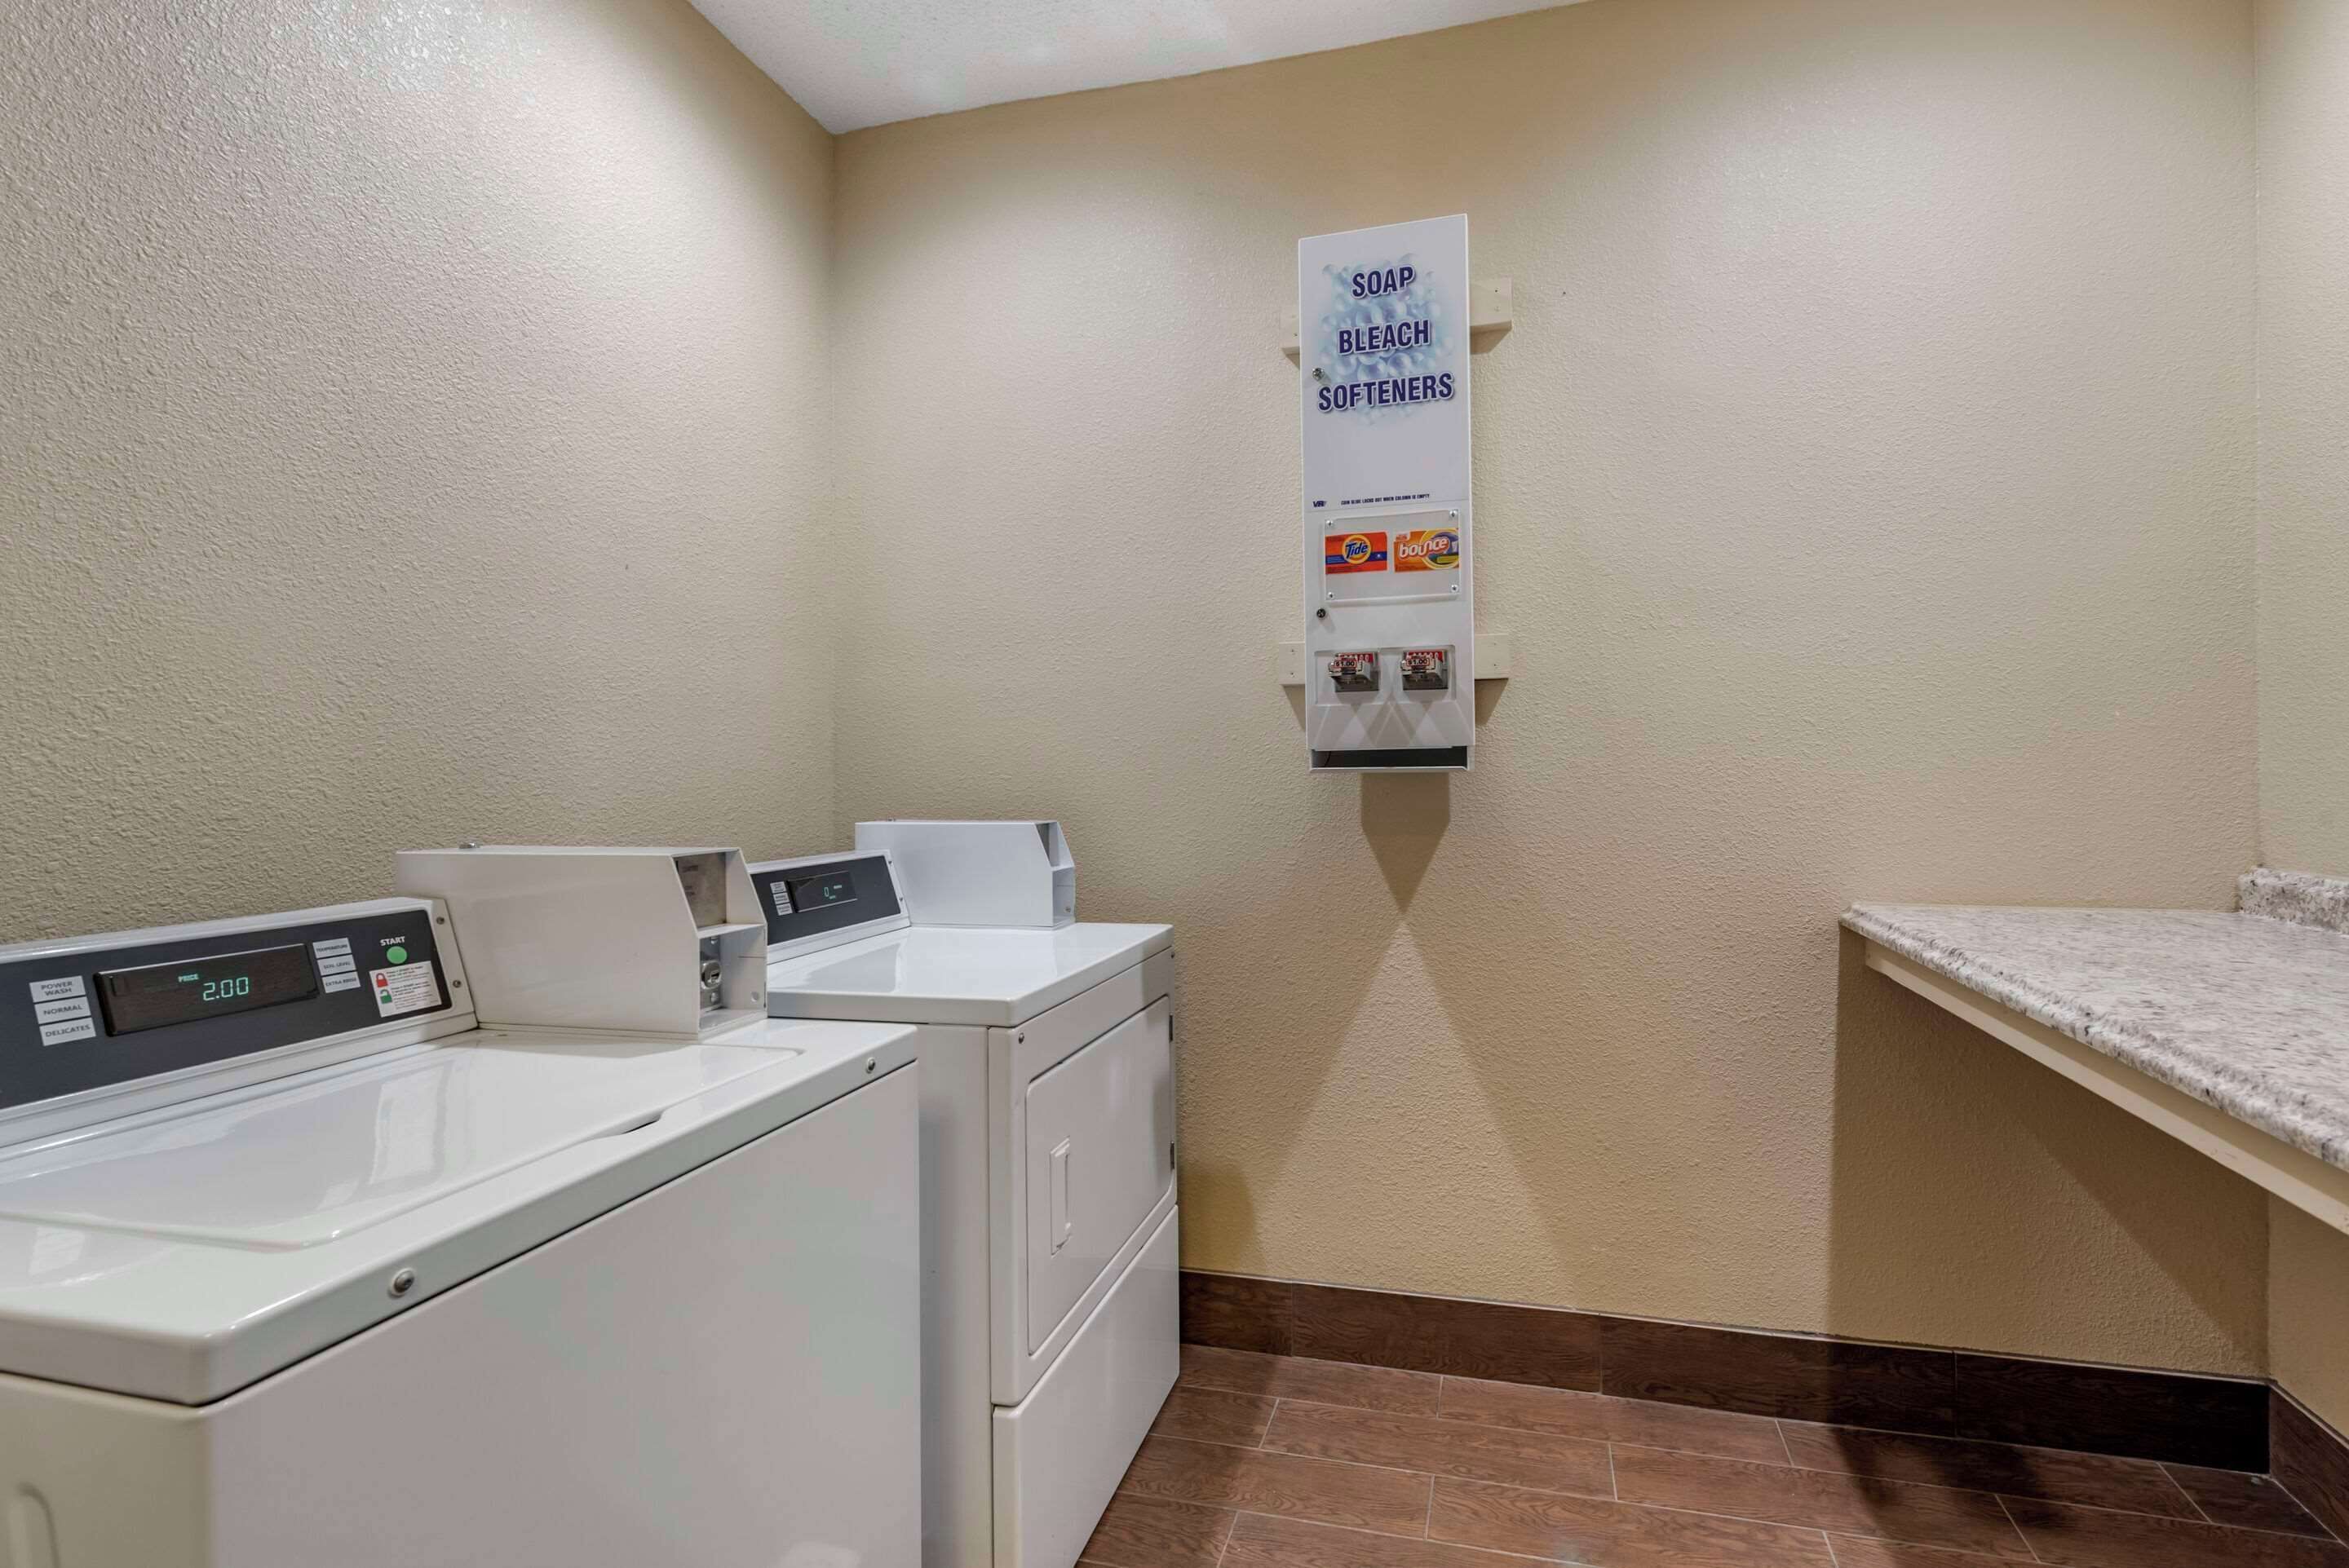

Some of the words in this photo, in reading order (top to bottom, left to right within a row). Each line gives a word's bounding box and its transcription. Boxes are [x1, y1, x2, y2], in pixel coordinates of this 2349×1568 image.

[1351, 266, 1414, 298] SOAP
[1338, 319, 1429, 354] BLEACH
[1318, 373, 1453, 411] SOFTENERS
[1345, 541, 1369, 559] Tide
[1398, 537, 1449, 559] bounce
[379, 936, 405, 947] START
[41, 981, 73, 990] POWER
[178, 974, 199, 983] PRICE
[44, 987, 73, 996] WASH
[203, 977, 249, 1001] 2.00
[43, 1004, 83, 1015] NORMAL
[45, 1024, 91, 1037] DELICATES
